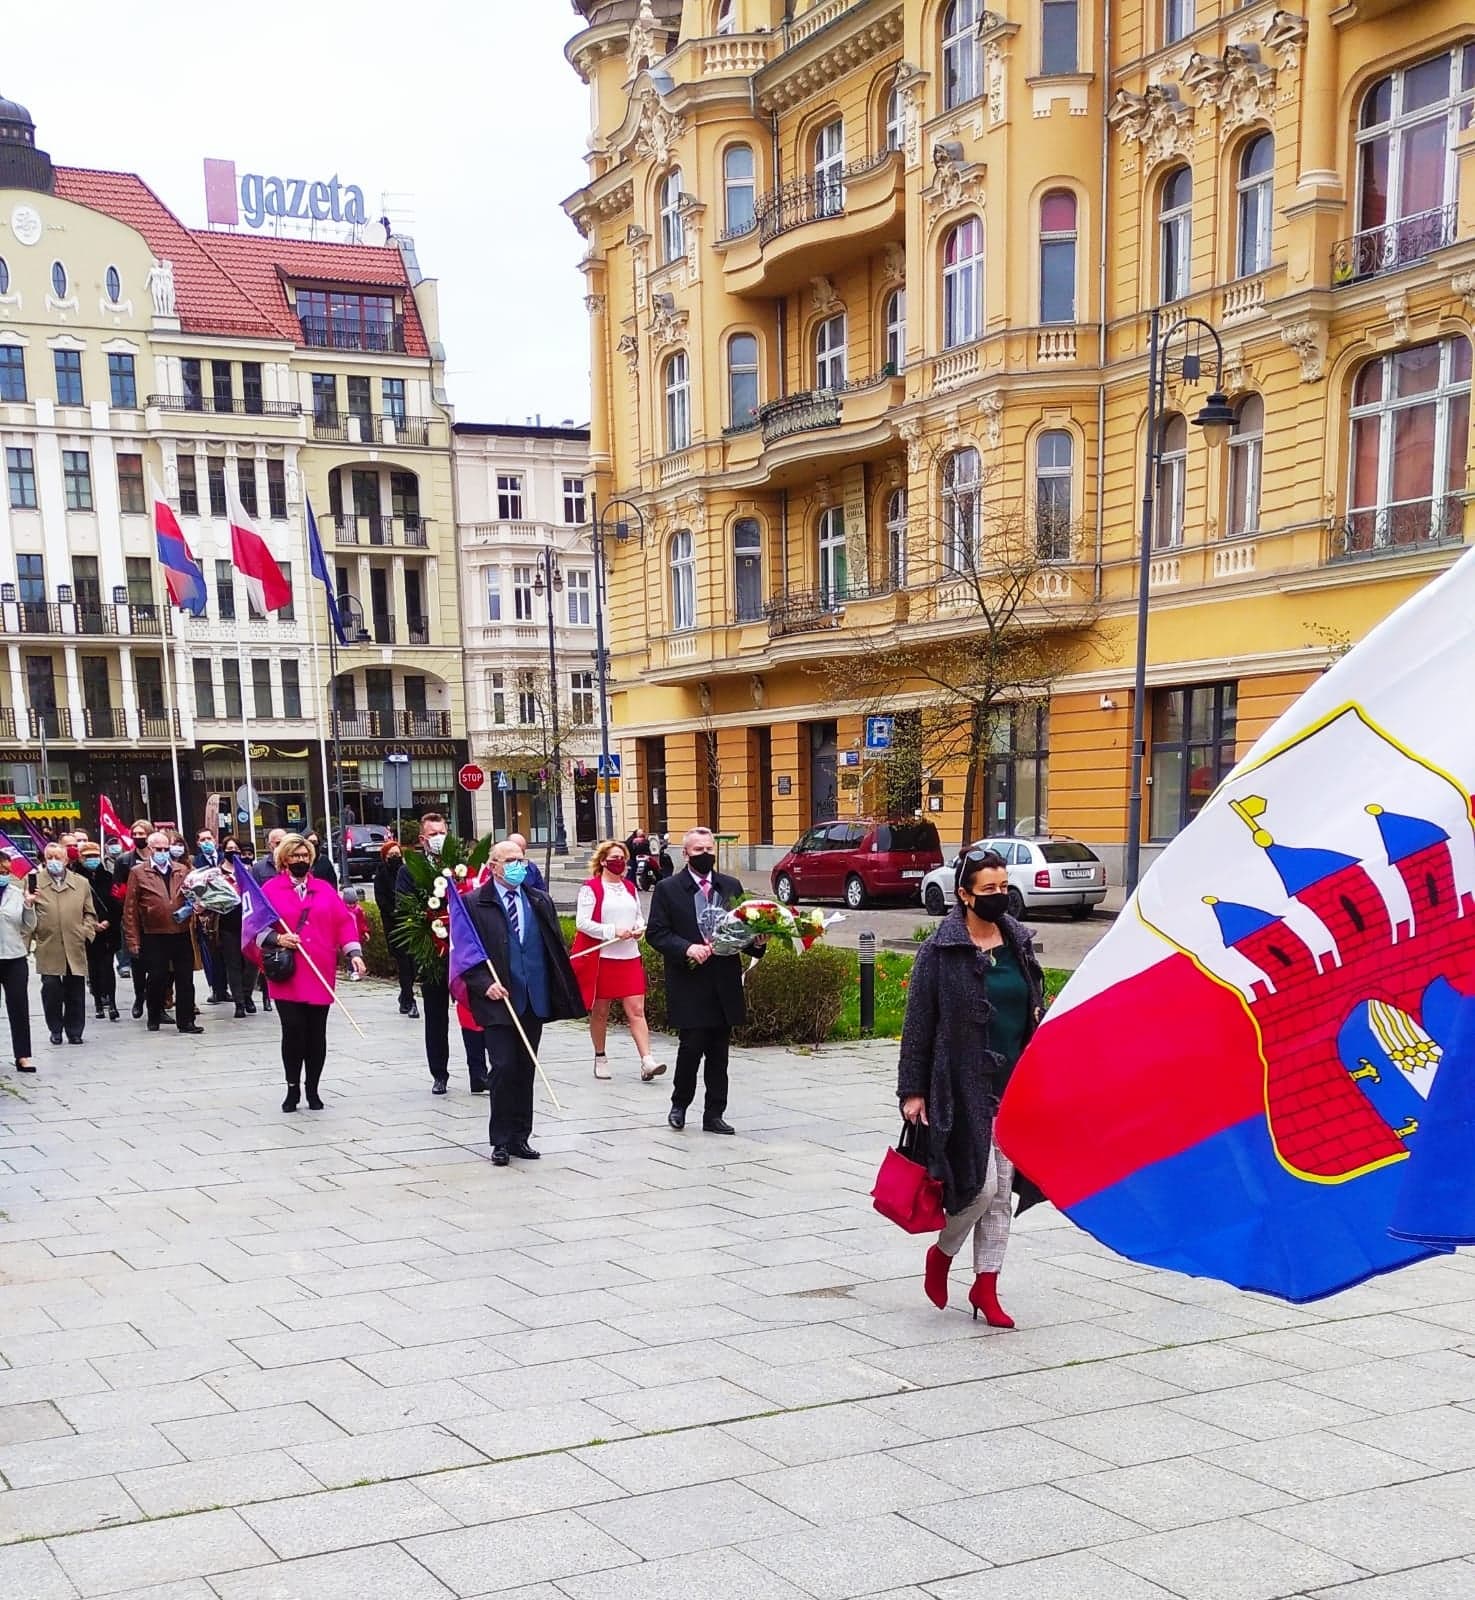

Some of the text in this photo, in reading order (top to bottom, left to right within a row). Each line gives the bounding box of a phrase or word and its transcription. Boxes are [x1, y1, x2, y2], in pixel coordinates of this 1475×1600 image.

[240, 173, 367, 228] gazeta
[873, 721, 889, 744] P
[330, 744, 457, 756] APTEKA CENTRALNA
[462, 774, 482, 782] STOP
